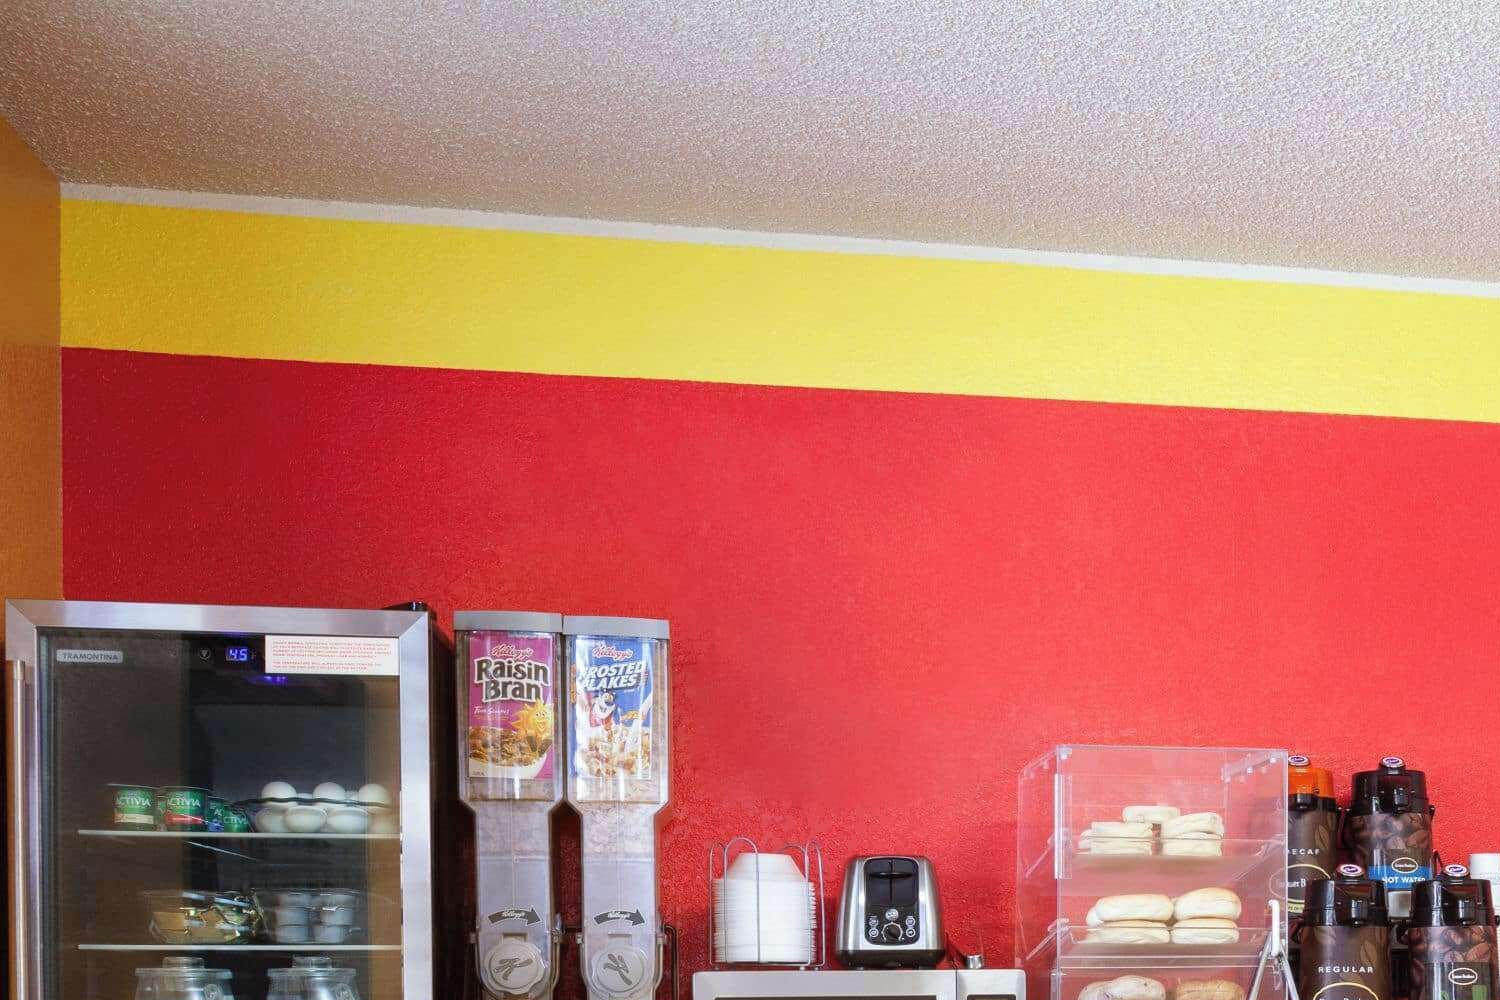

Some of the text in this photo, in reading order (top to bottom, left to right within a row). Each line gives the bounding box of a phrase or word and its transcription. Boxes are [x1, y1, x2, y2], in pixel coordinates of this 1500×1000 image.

[63, 651, 118, 660] TRAMONTINA
[228, 649, 248, 661] 45
[474, 656, 551, 687] Raisin
[482, 679, 543, 702] Bran
[1318, 966, 1374, 974] REGULAR
